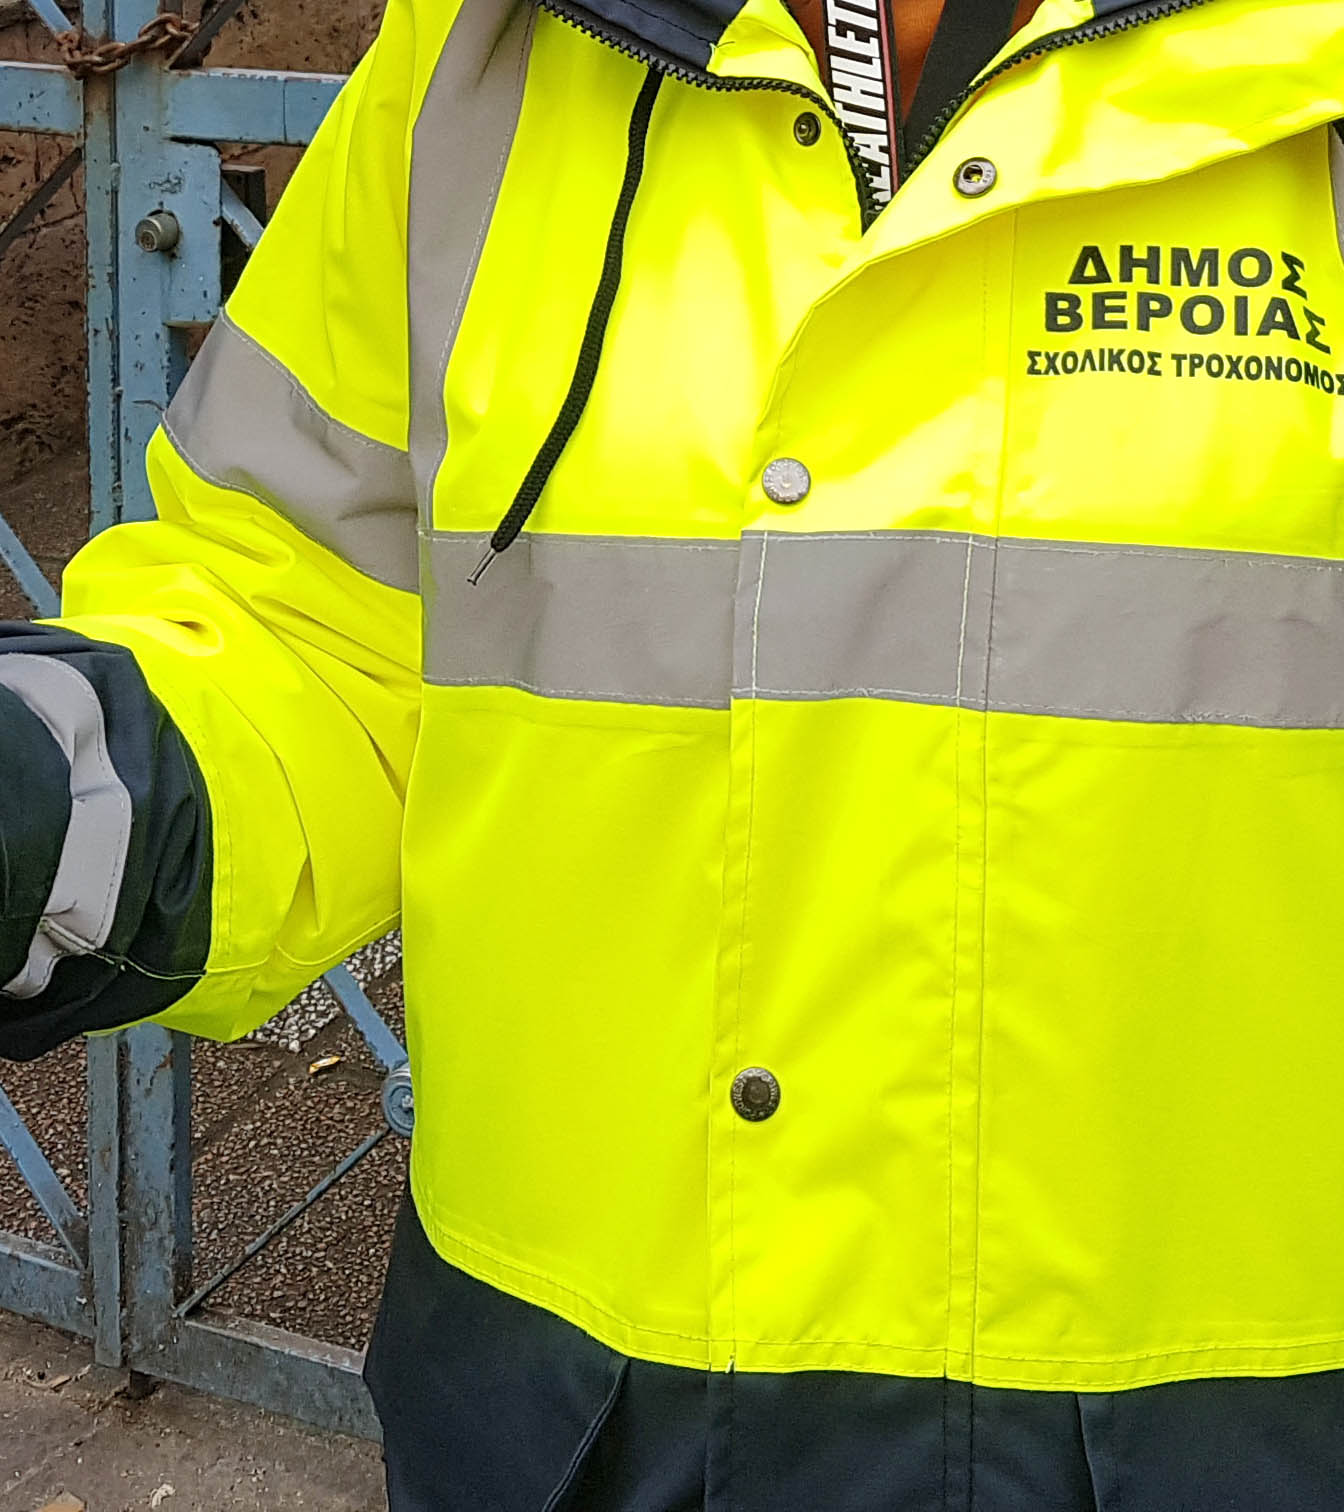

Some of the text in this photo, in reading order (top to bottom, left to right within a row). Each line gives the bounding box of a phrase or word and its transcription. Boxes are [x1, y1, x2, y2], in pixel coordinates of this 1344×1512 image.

[1068, 245, 1308, 300] ΔΗΜΟΣ
[1045, 291, 1331, 355] ΒΕΡΟΙΑΣ
[1027, 348, 1162, 376] ΣΧΟΛΙΚΟΣ
